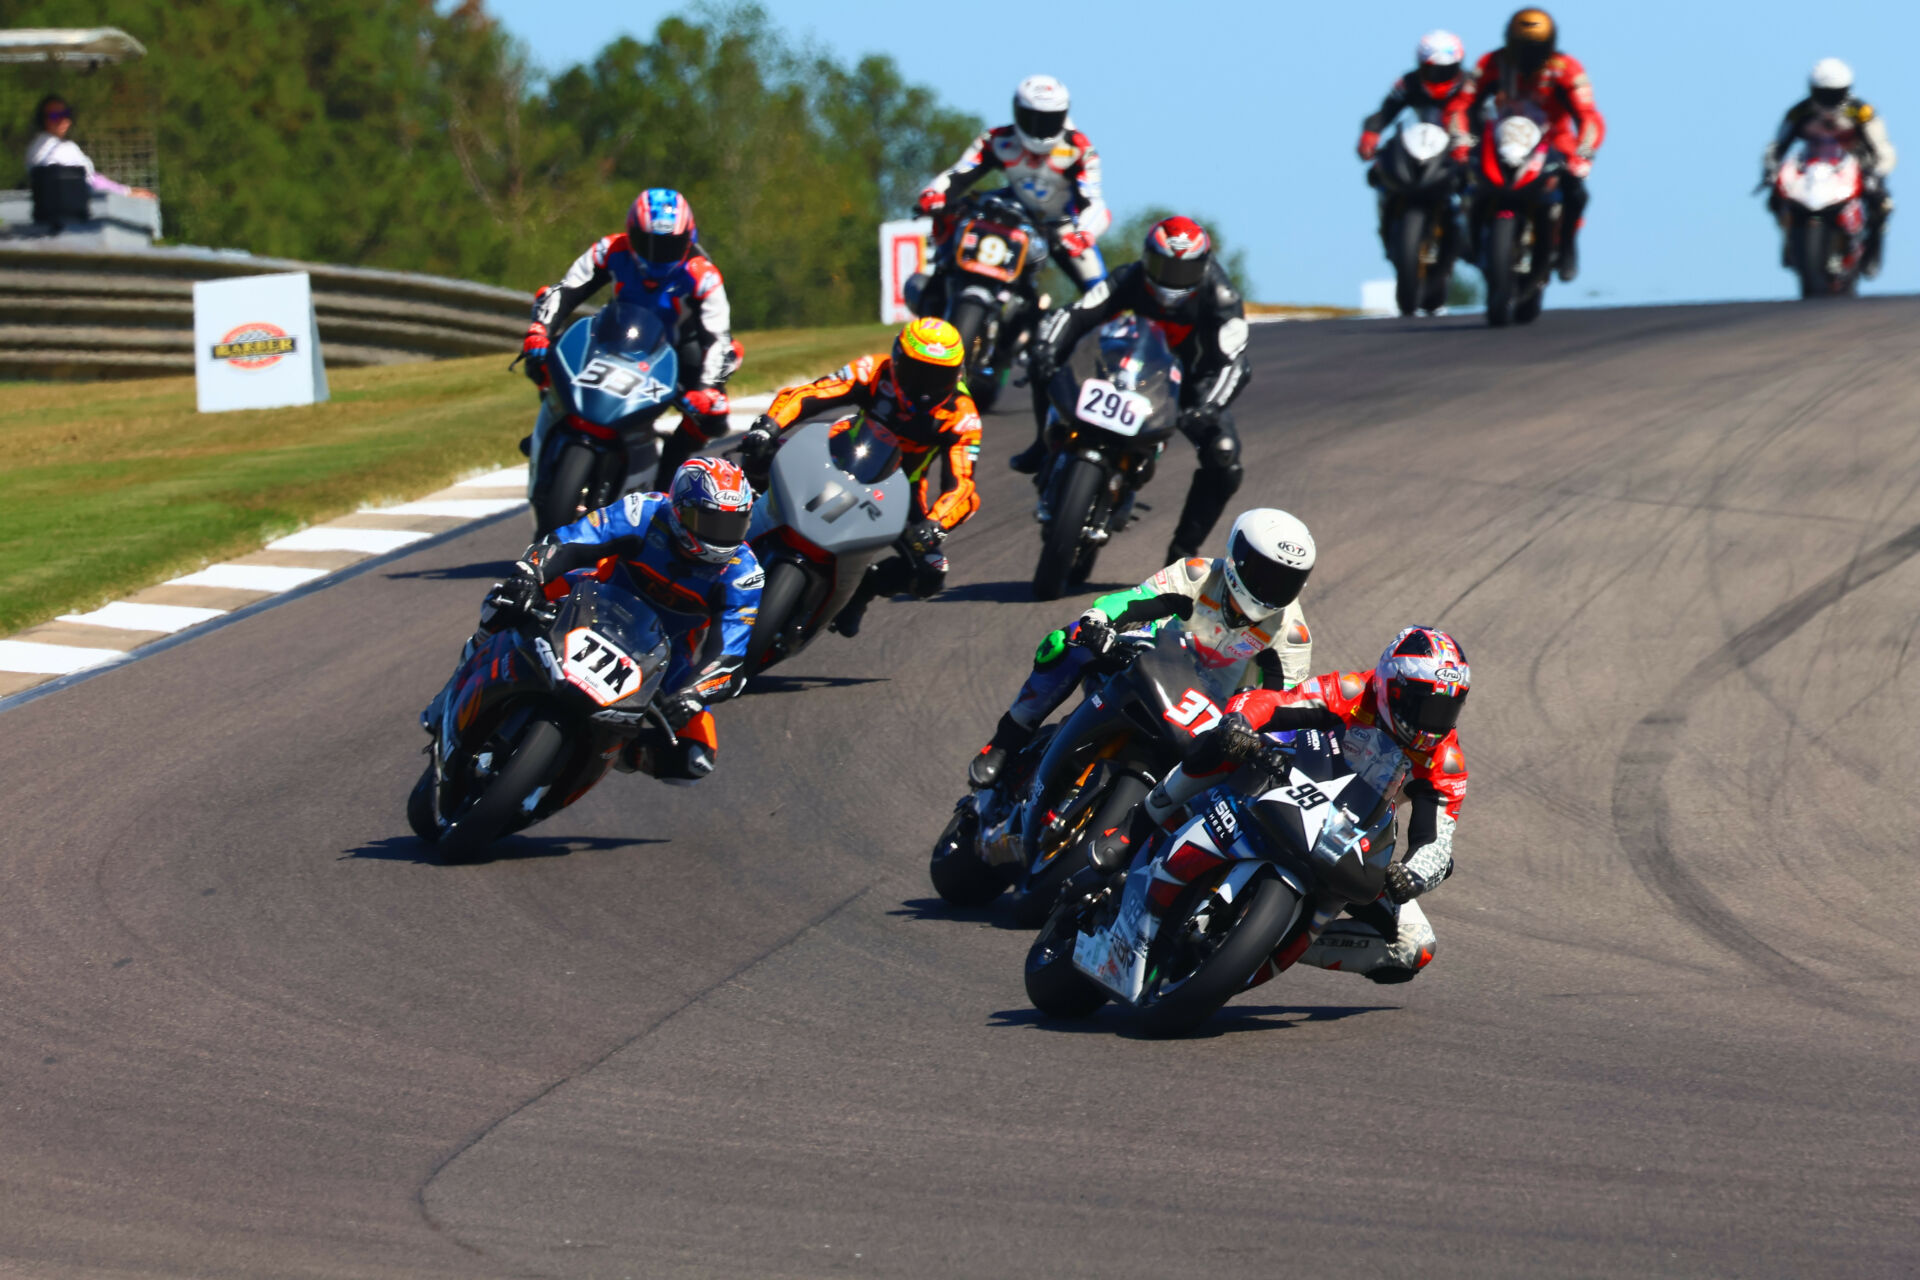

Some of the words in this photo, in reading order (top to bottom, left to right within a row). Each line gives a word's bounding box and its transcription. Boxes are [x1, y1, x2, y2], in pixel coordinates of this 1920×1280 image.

[1083, 388, 1137, 427] 296
[1281, 542, 1304, 555] KYT
[570, 634, 634, 695] 77X
[1165, 690, 1224, 737] 37
[1286, 782, 1331, 812] 99
